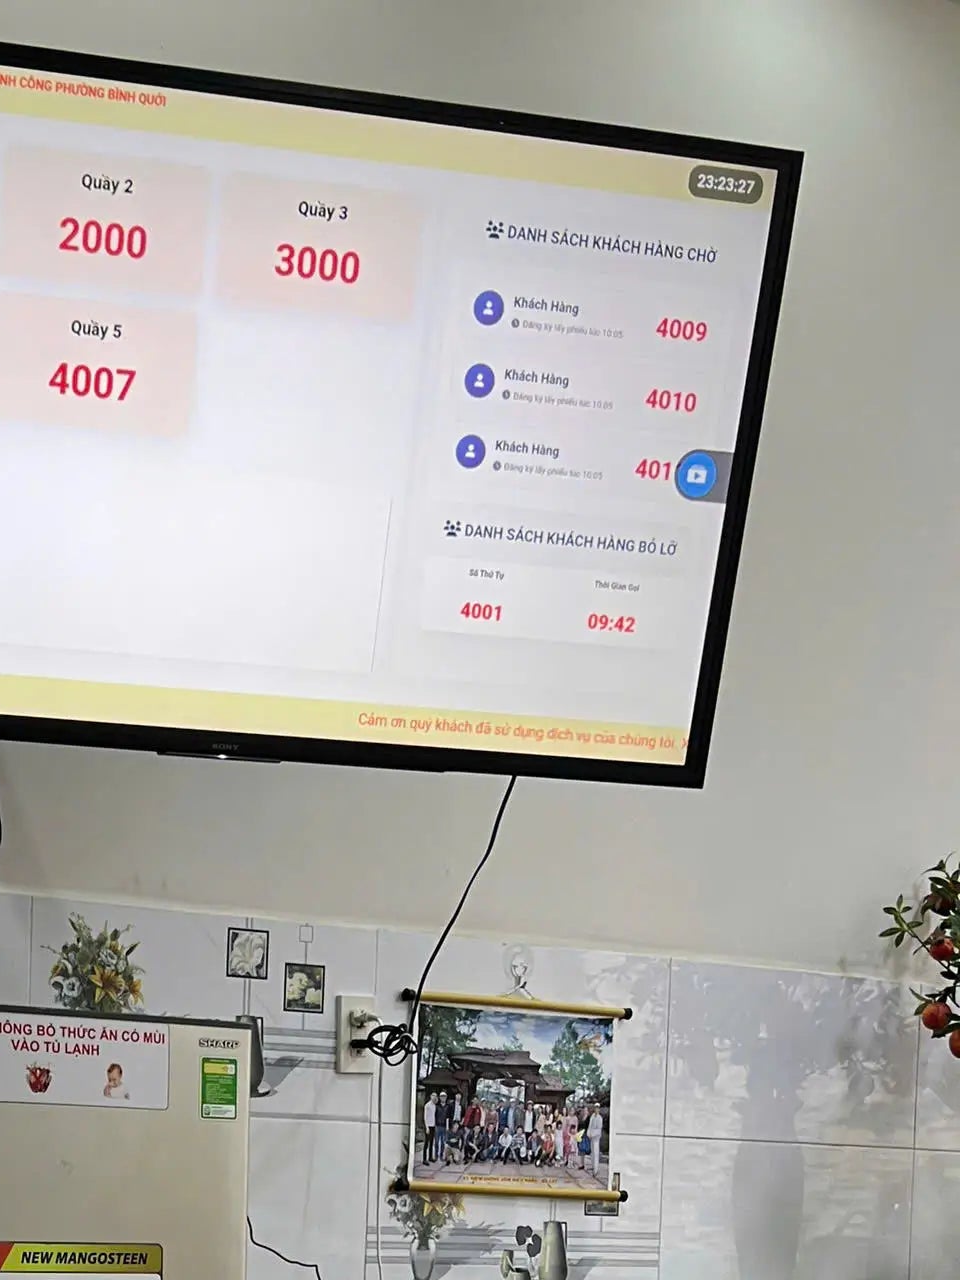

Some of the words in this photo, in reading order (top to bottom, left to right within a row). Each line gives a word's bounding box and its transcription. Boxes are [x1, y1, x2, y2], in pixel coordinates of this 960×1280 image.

[20, 75, 52, 91] CÔNG
[56, 82, 104, 98] PHƯỜNG
[108, 87, 135, 102] BÌNH
[81, 173, 118, 194] Quầy
[124, 179, 133, 193] 2
[697, 173, 755, 195] 23:23:27
[297, 201, 334, 222] Quầy
[340, 206, 348, 221] 3
[59, 218, 147, 258] 2000
[508, 224, 547, 243] DANH
[550, 227, 589, 249] SÁCH
[593, 232, 641, 255] KHÁCH
[644, 238, 683, 260] HÀNG
[687, 246, 717, 263] CHỜ
[274, 244, 360, 284] 3000
[514, 296, 547, 313] Khách
[550, 299, 579, 317] Hàng
[71, 319, 109, 341] Quầy
[113, 324, 122, 339] 5
[656, 317, 707, 342] 4009
[49, 363, 136, 400] 4007
[504, 368, 538, 385] Khách
[541, 371, 569, 388] Hàng
[645, 388, 697, 413] 4010
[495, 440, 528, 457] Khách
[531, 442, 560, 459] Hàng
[635, 459, 672, 482] 401
[465, 524, 503, 540] DANH
[506, 525, 544, 544] SÁCH
[547, 530, 593, 548] KHÁCH
[597, 534, 635, 552] HÀNG
[660, 540, 677, 556] LỠ
[461, 602, 502, 622] 4001
[588, 613, 635, 633] 09:42
[391, 717, 407, 729] ơn
[435, 718, 473, 735] khách
[60, 1024, 96, 1040] THỨC
[100, 1027, 118, 1041] ĂN
[121, 1028, 140, 1042] CÓ
[143, 1029, 165, 1044] MÙI
[199, 1038, 240, 1049] SHARP
[11, 1037, 40, 1052] VÀO
[65, 1043, 100, 1058] LẠNH
[21, 1251, 52, 1264] NEW
[55, 1251, 148, 1265] MANGOSTEEN
